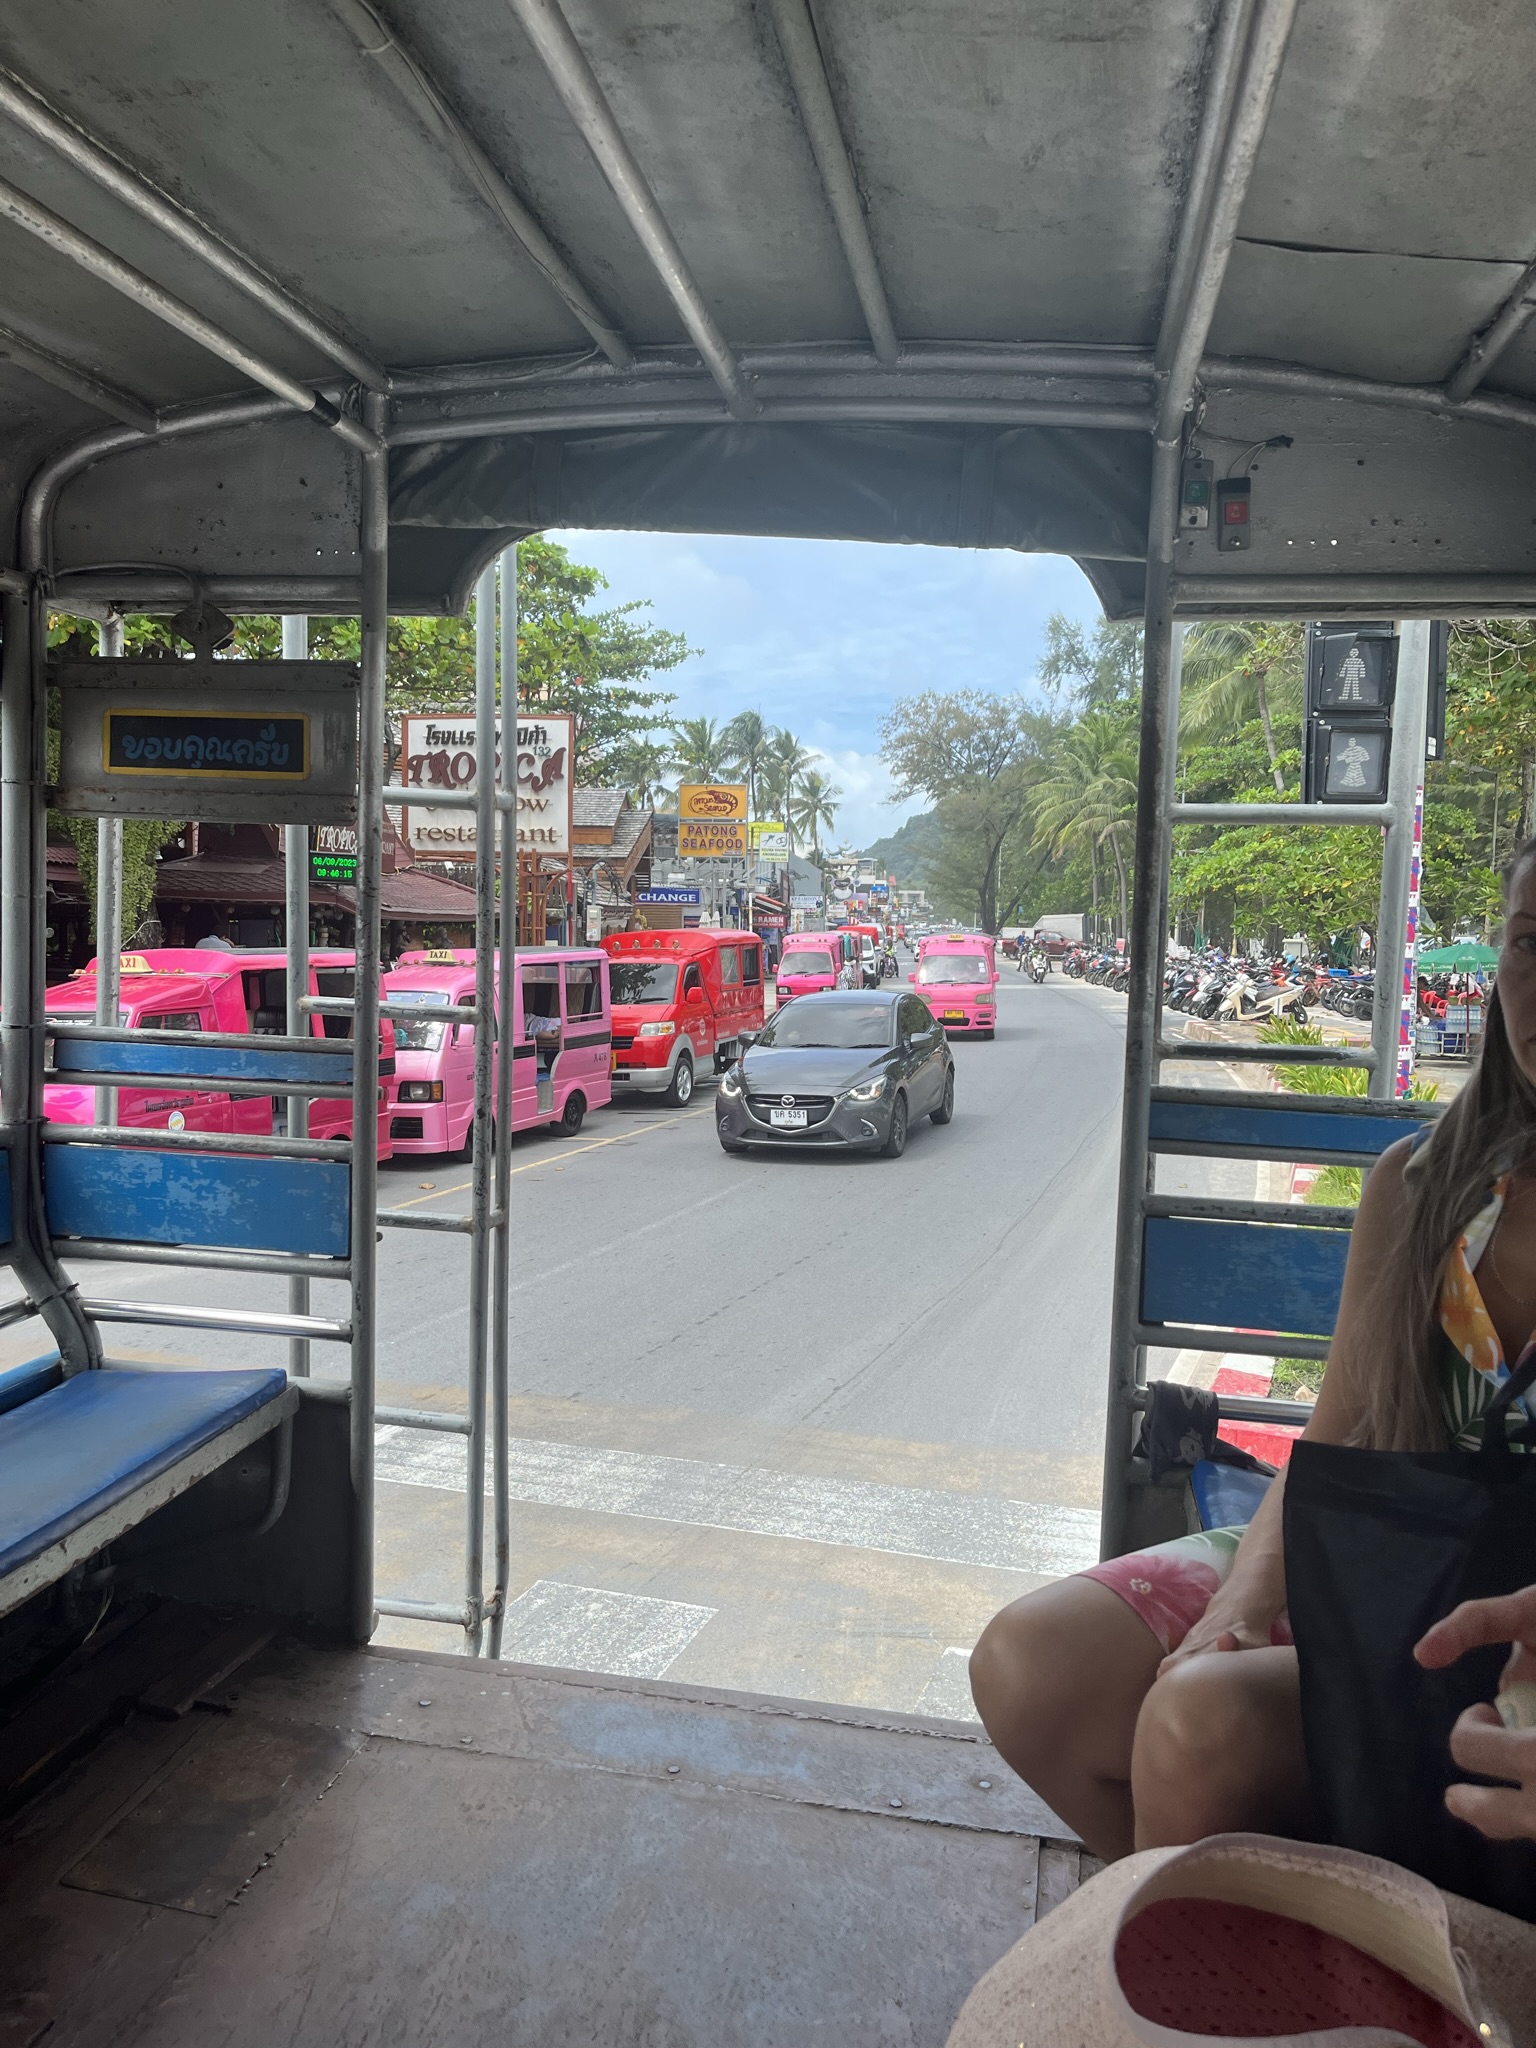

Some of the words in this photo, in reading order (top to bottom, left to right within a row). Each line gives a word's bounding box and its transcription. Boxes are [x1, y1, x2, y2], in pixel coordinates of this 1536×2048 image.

[533, 746, 551, 757] 132
[407, 747, 567, 792] TROCA
[415, 826, 557, 844] restaant
[687, 825, 738, 836] PATONG
[682, 838, 743, 849] SEAFOOD
[430, 951, 448, 959] TAXI
[788, 1111, 805, 1119] 5351
